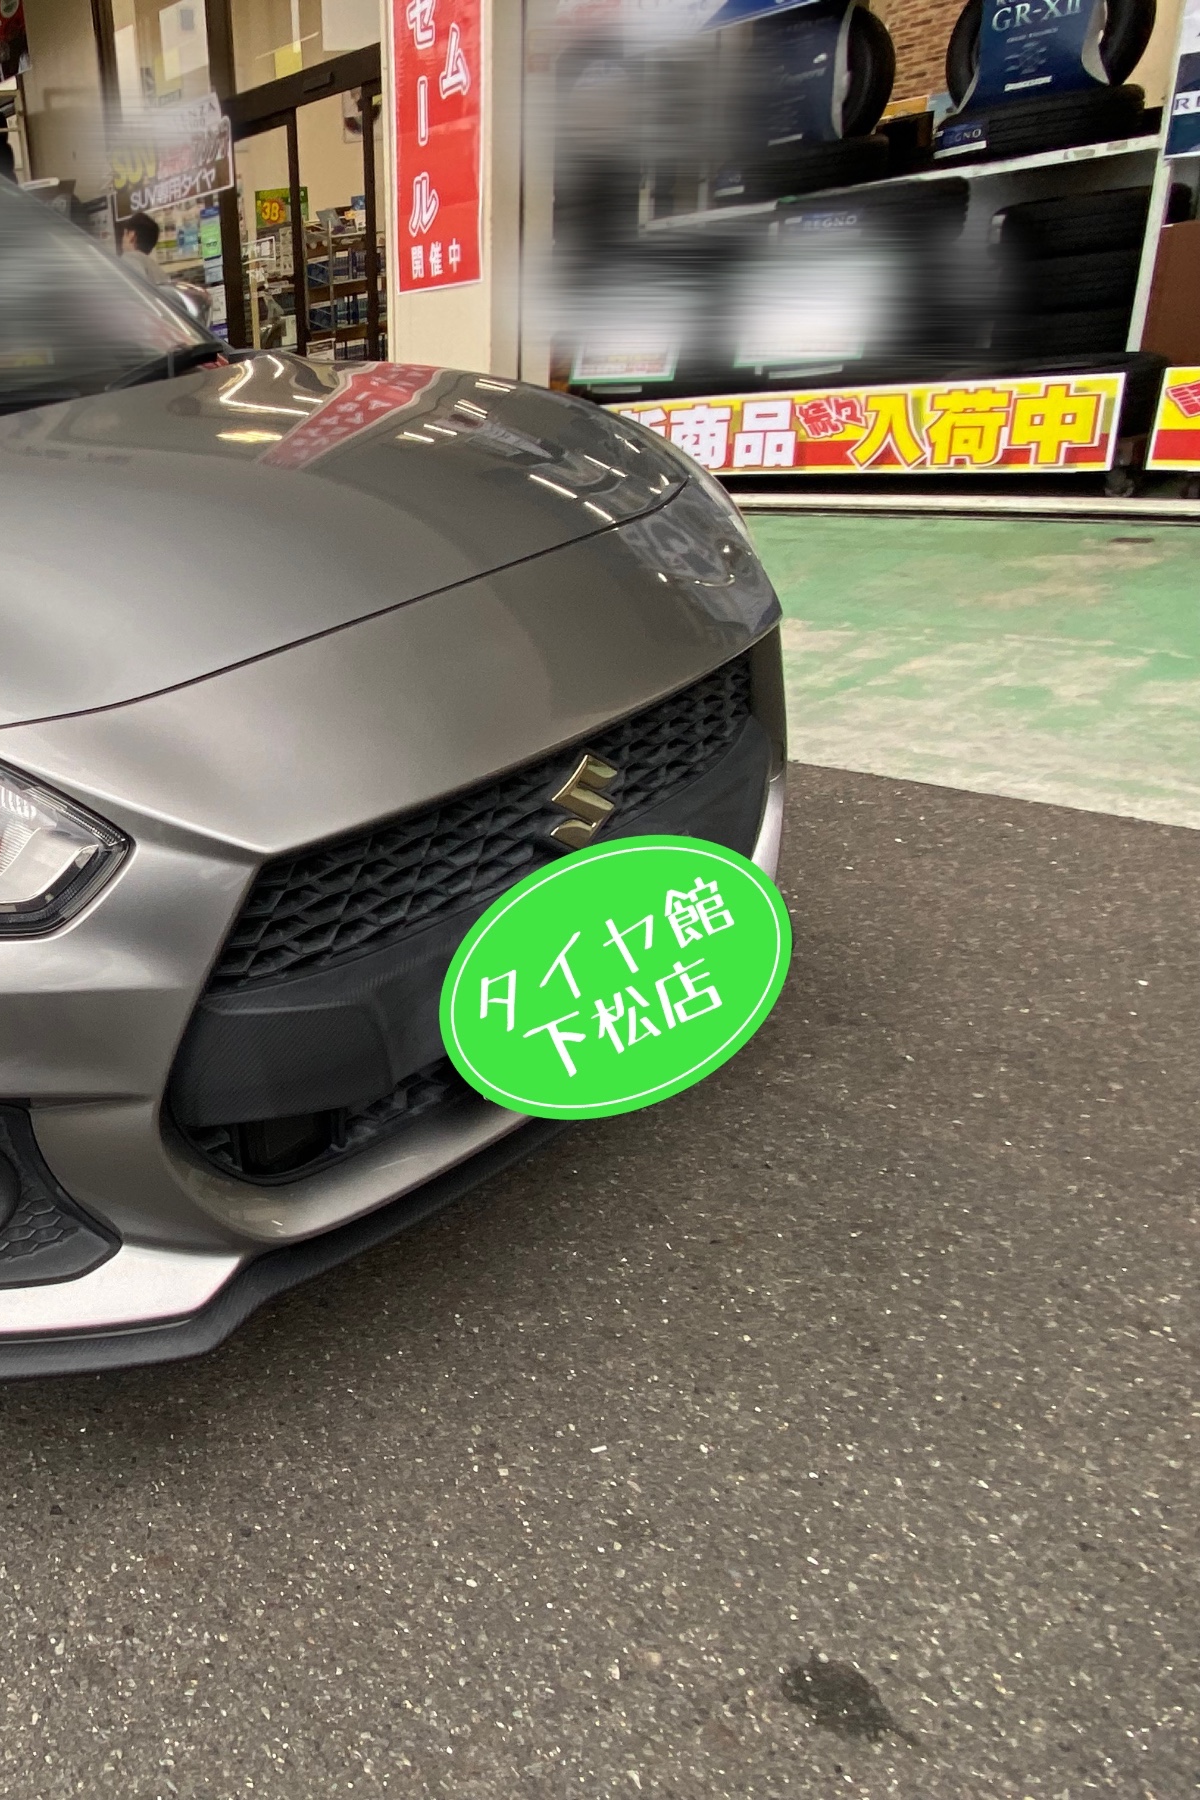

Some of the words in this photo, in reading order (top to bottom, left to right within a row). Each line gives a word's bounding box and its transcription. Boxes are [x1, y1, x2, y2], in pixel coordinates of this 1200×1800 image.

[410, 237, 461, 280] 開催中
[848, 384, 1104, 470] 入荷中
